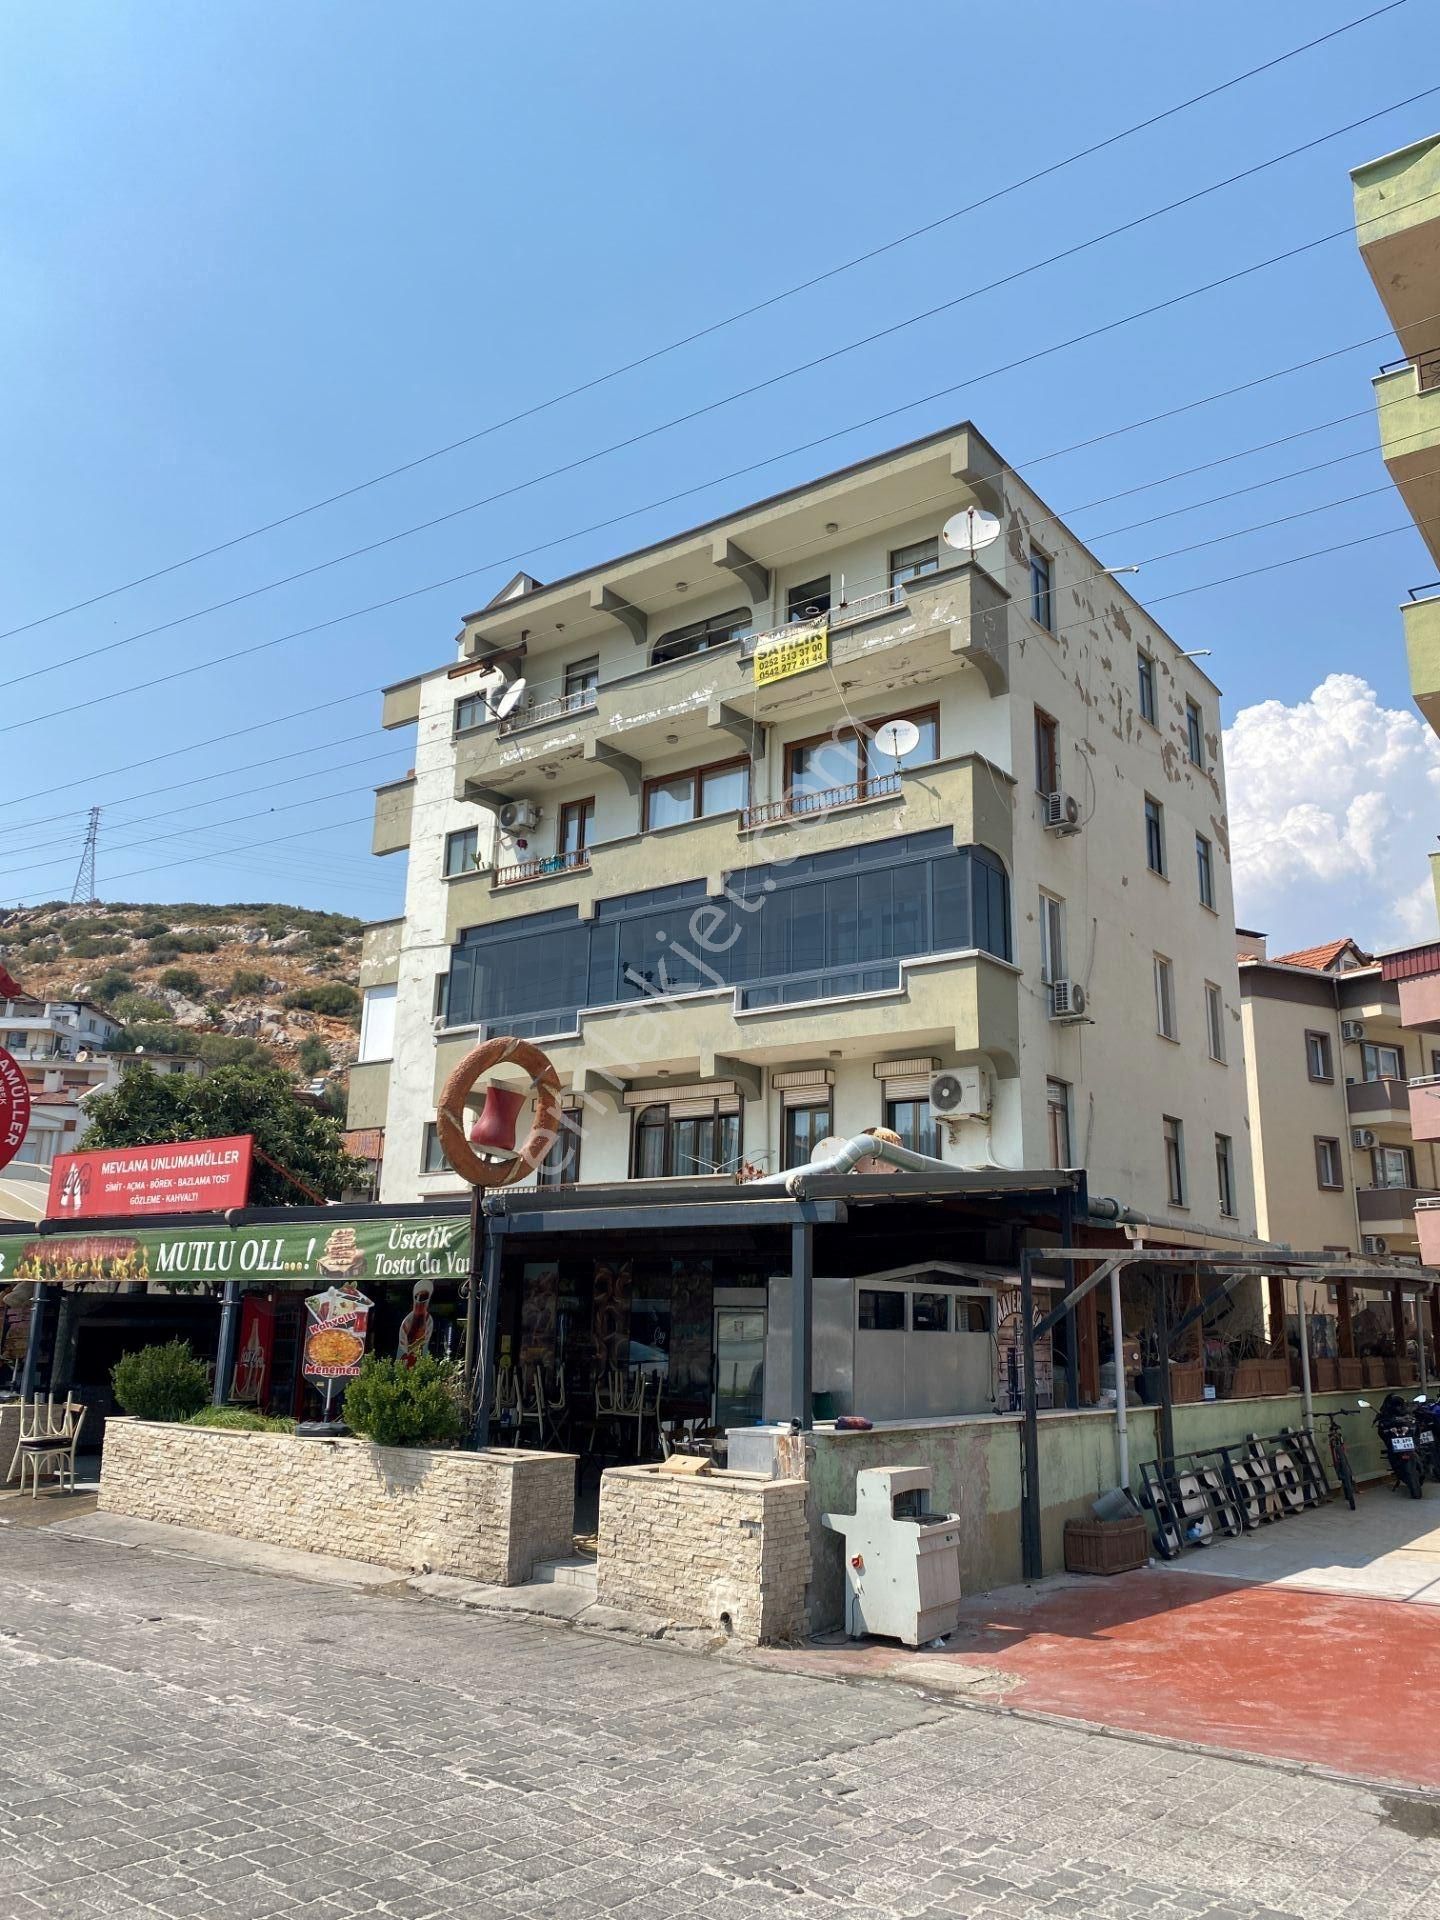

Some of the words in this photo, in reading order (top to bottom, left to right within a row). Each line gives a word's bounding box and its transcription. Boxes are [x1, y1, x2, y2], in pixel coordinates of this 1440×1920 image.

[759, 657, 778, 670] 0252
[781, 651, 797, 664] 513
[799, 646, 810, 658] 37
[811, 642, 823, 653] 00
[759, 666, 779, 680] 0542
[781, 661, 797, 673] 277
[799, 657, 810, 668] 41
[101, 1158, 149, 1175] MEVLANA
[150, 1149, 240, 1171] UNLUMAMÜLLER
[149, 1178, 173, 1189] BÖREK
[177, 1175, 211, 1187] BAZLAMA
[211, 1174, 231, 1184] TOST
[129, 1194, 161, 1206] GÖZLEME
[155, 1241, 237, 1272] MUTLU
[305, 1364, 360, 1375] Menemen
